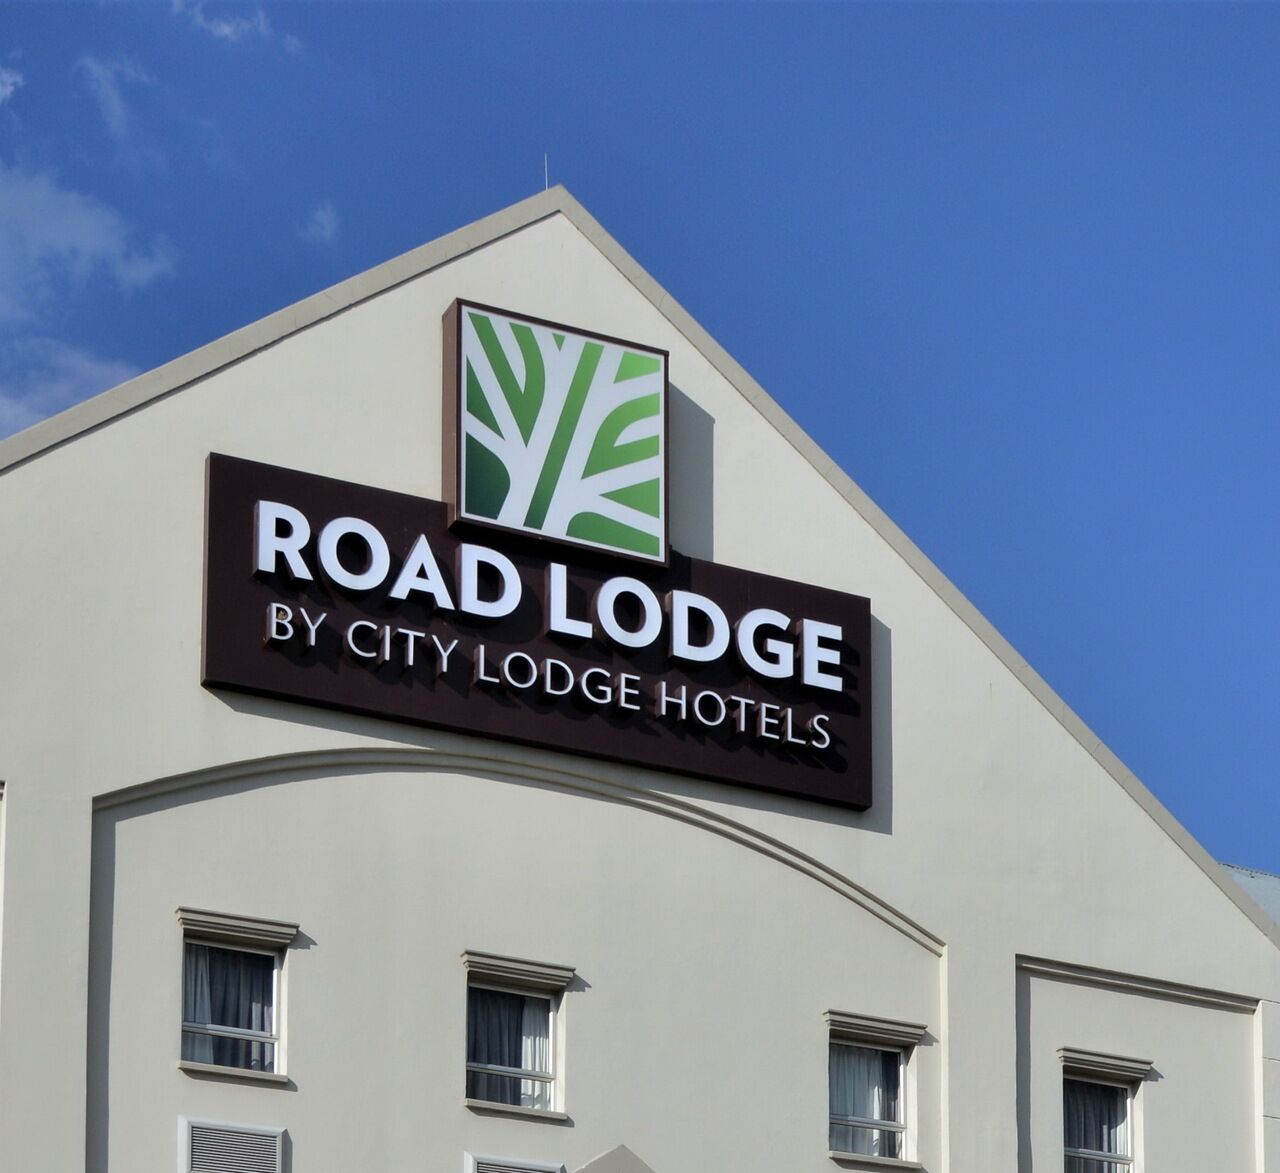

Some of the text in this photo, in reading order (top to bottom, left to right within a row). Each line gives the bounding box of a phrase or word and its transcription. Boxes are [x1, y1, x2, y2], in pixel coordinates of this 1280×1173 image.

[256, 499, 843, 692] ROAD LODGE
[269, 602, 831, 749] BY CITY LODGE HOTELS
